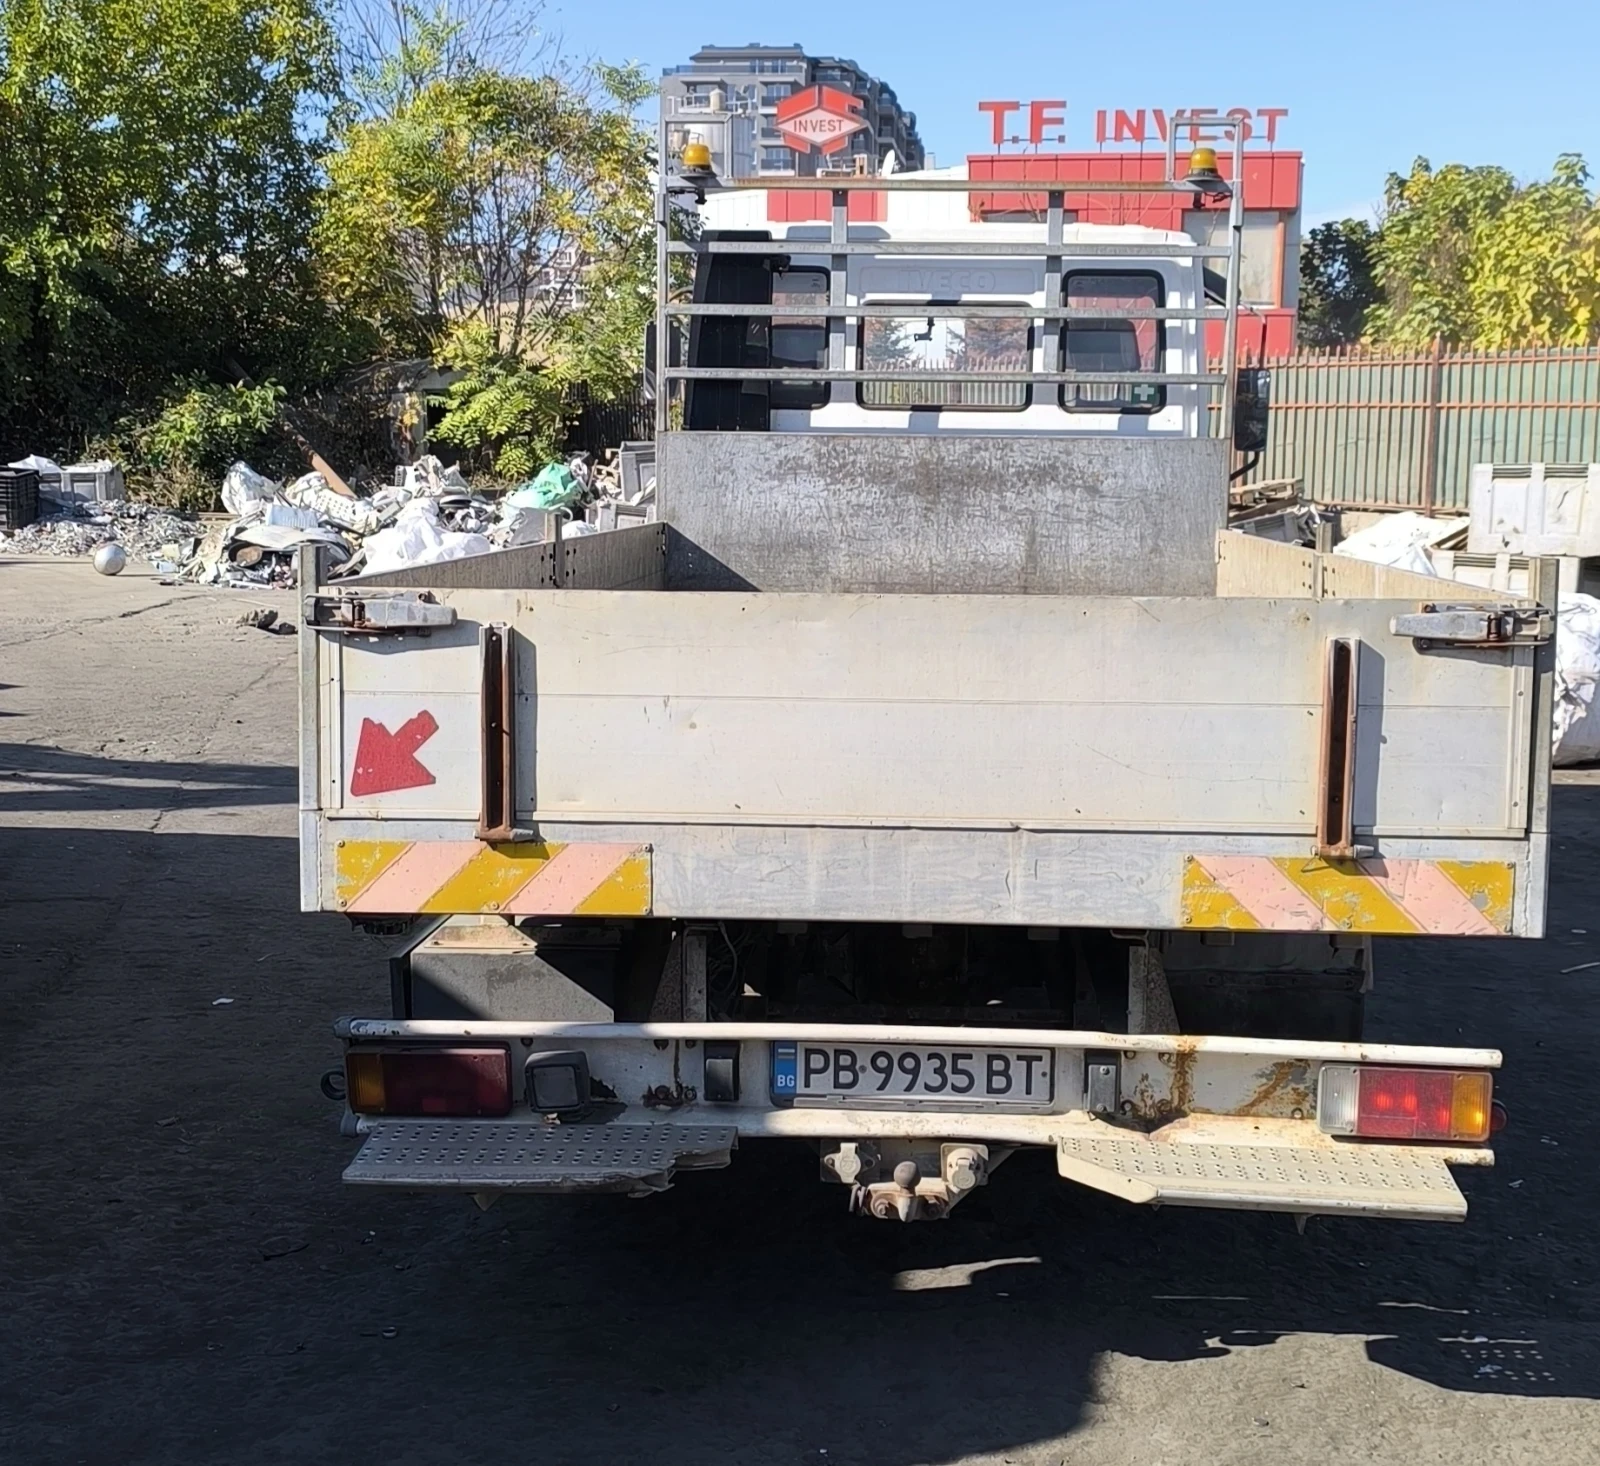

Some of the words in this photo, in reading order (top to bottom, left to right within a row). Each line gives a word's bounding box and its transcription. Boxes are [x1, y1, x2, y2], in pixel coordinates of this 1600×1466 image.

[793, 119, 844, 133] INVEST
[978, 100, 1067, 144] T.F.
[1096, 107, 1288, 143] INVEST
[900, 268, 997, 293] IVECO
[777, 1074, 796, 1088] BG
